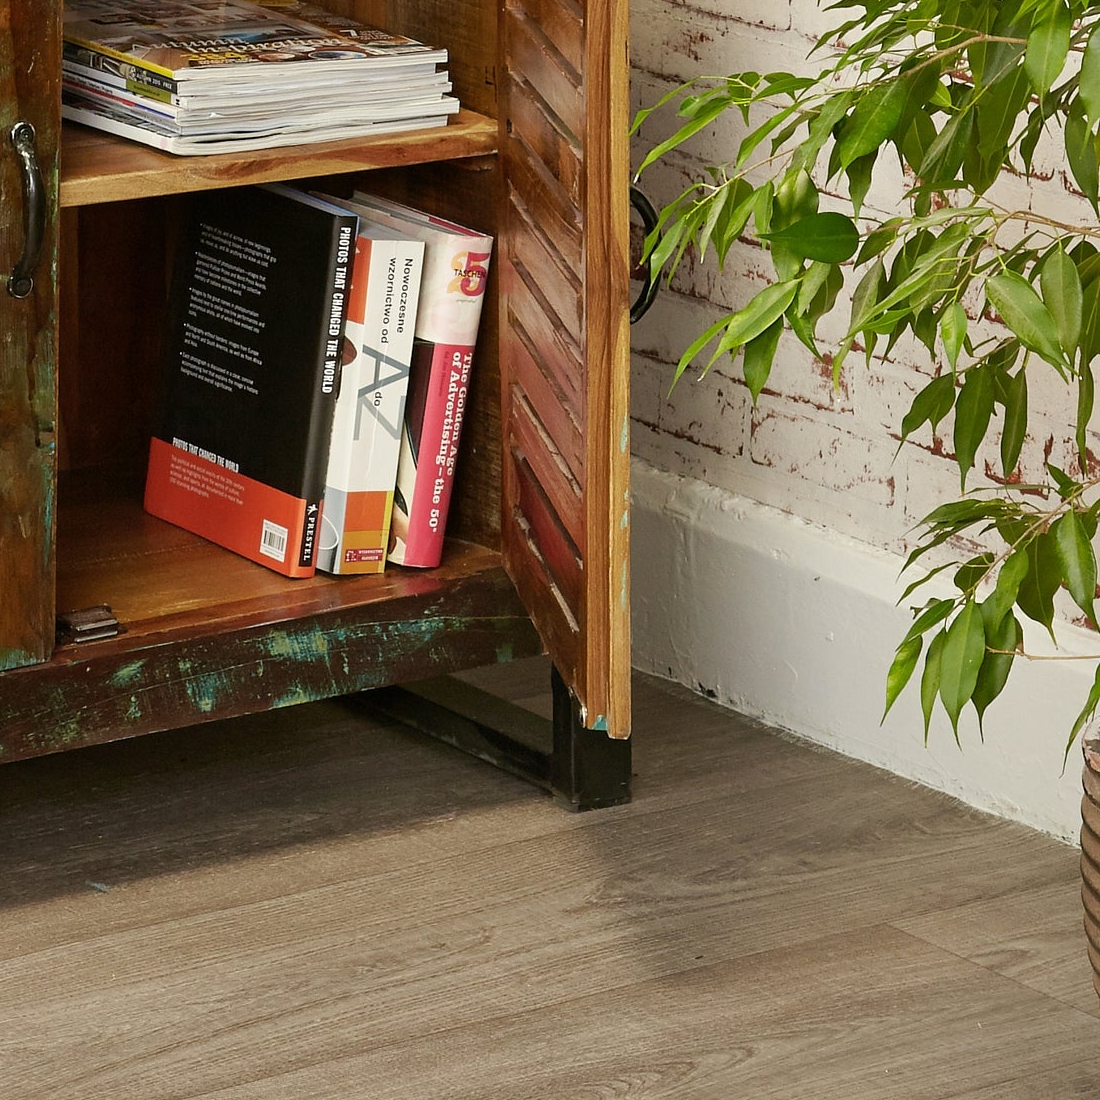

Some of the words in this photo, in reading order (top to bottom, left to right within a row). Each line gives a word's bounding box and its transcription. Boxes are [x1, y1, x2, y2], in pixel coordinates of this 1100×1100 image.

[187, 36, 343, 54] Inspiration
[337, 227, 352, 263] PHOTOS
[334, 266, 346, 290] THAT
[454, 268, 486, 279] TASCHEN
[382, 257, 397, 325] wzornictwo
[396, 258, 414, 334] Nowoczesne
[328, 293, 344, 336] CHANGED
[326, 339, 339, 357] THE
[380, 328, 389, 344] od
[357, 343, 411, 399] A
[452, 351, 462, 368] of
[460, 352, 473, 383] The
[321, 360, 336, 394] WORLD
[373, 391, 383, 407] do
[452, 386, 468, 442] Golden
[172, 436, 188, 452] PHOTOS
[188, 443, 199, 456] THAT
[198, 447, 217, 464] CHANGED
[217, 455, 225, 468] THE
[224, 459, 239, 474] WORLD
[446, 444, 458, 476] Age
[303, 517, 316, 561] PRESTEL
